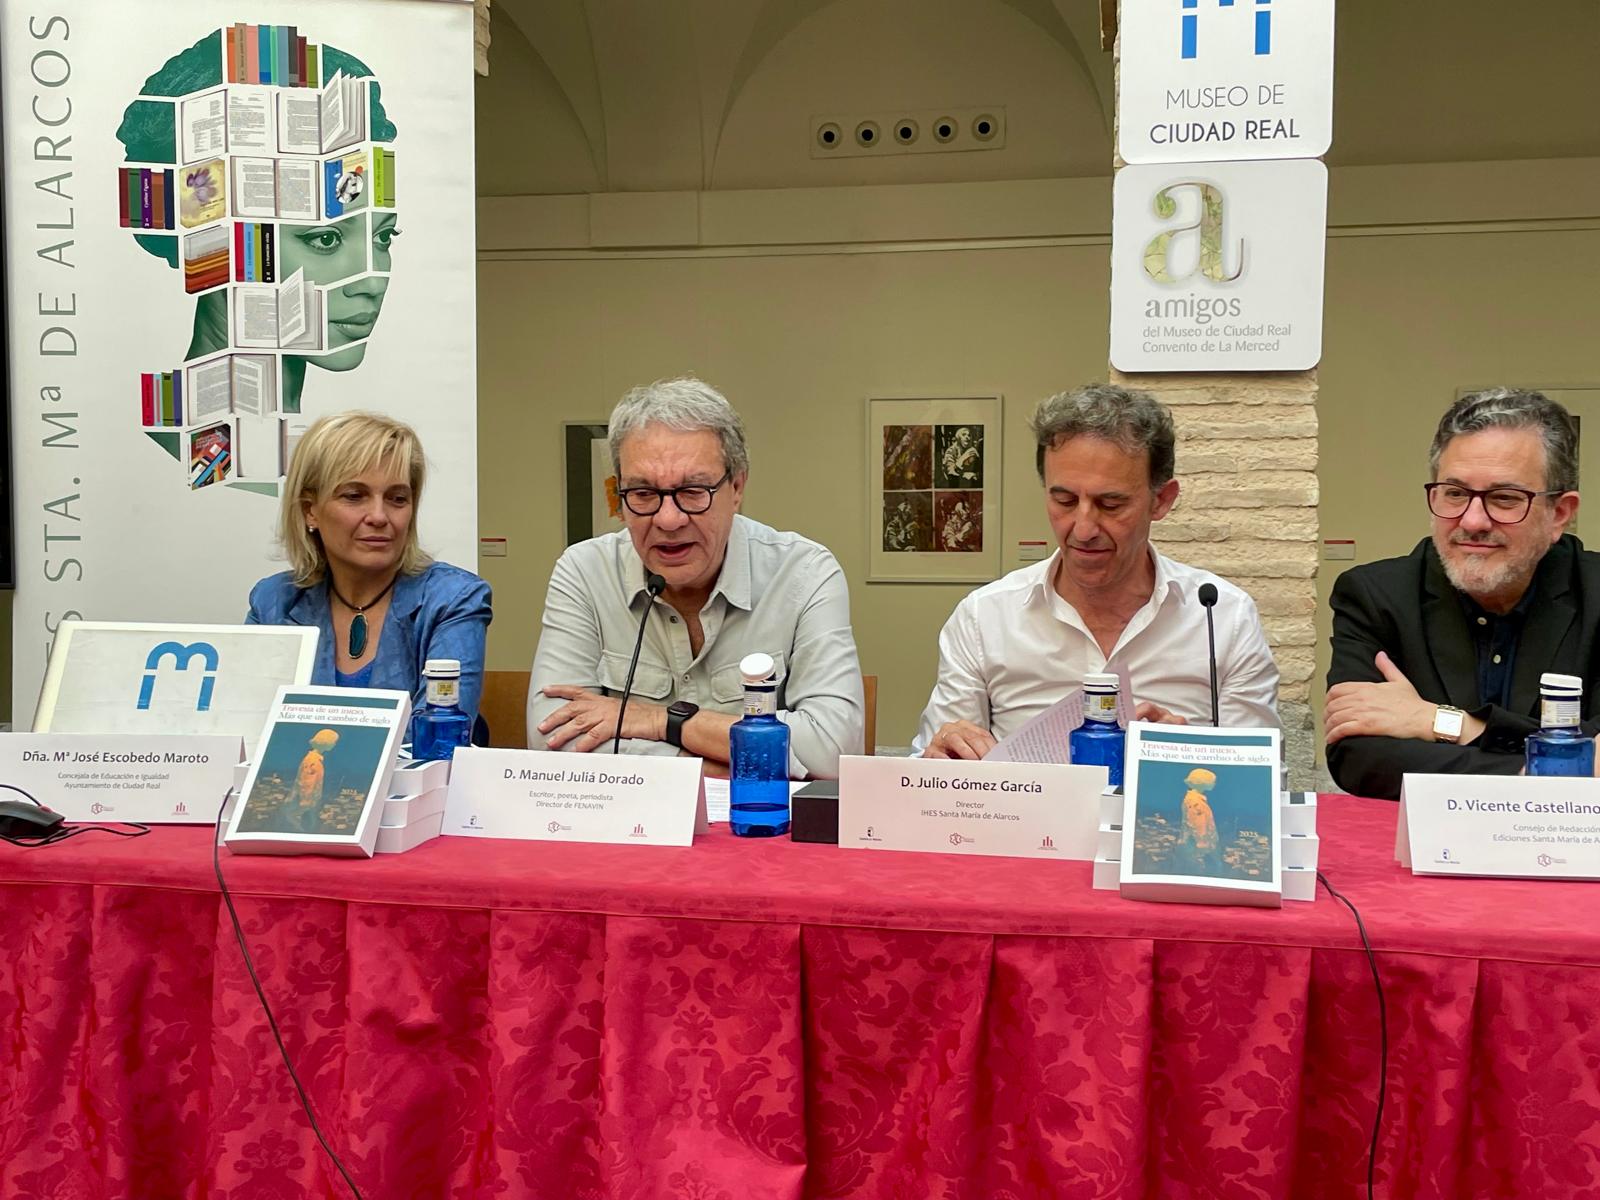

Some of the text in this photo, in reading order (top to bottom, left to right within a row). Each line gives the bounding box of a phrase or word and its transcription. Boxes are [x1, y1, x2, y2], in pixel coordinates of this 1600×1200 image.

[1166, 84, 1285, 110] MUSEO DE
[1150, 119, 1300, 144] CIUDAD REAL
[29, 15, 76, 269] ALARCOS
[1145, 293, 1241, 325] amigos
[38, 291, 78, 357] DE
[1142, 324, 1291, 338] del Museo de Ciudad Real
[1142, 339, 1280, 353] Convento de La Merced
[43, 476, 84, 582] STA.
[316, 705, 327, 713] de
[297, 713, 313, 721] que
[327, 714, 358, 722] cambio
[359, 715, 370, 723] de
[372, 716, 391, 725] siglo
[1180, 744, 1192, 753] de
[23, 750, 209, 764] Dña. Mª José Escobedo Maroto
[1162, 751, 1179, 760] que
[1196, 753, 1231, 762] cambio
[1233, 754, 1245, 762] de
[1247, 754, 1270, 763] siglo
[58, 771, 90, 780] Concejala
[91, 772, 100, 780] de
[101, 771, 134, 780] Educación
[141, 772, 170, 781] Igualdad
[504, 768, 644, 785] D. Manuel Juliá Dorado
[64, 781, 161, 790] Ayuntamiento de Ciudad Real
[901, 776, 1042, 793] D. Julio Gómez García
[529, 790, 614, 801] Escritor, poeta, periodista
[564, 801, 573, 809] de
[574, 802, 604, 810] FENAVIN
[956, 800, 985, 809] Director
[1447, 799, 1600, 814] D. Vicente Castellano
[939, 810, 959, 818] Santa
[961, 811, 981, 819] María
[982, 812, 992, 820] de
[993, 813, 1020, 821] Alarcos
[1513, 824, 1545, 833] Consejo
[1547, 824, 1557, 832] de
[1493, 834, 1530, 843] Ediciones
[1532, 835, 1555, 843] Santa
[1557, 835, 1580, 843] María
[1581, 835, 1593, 843] de
